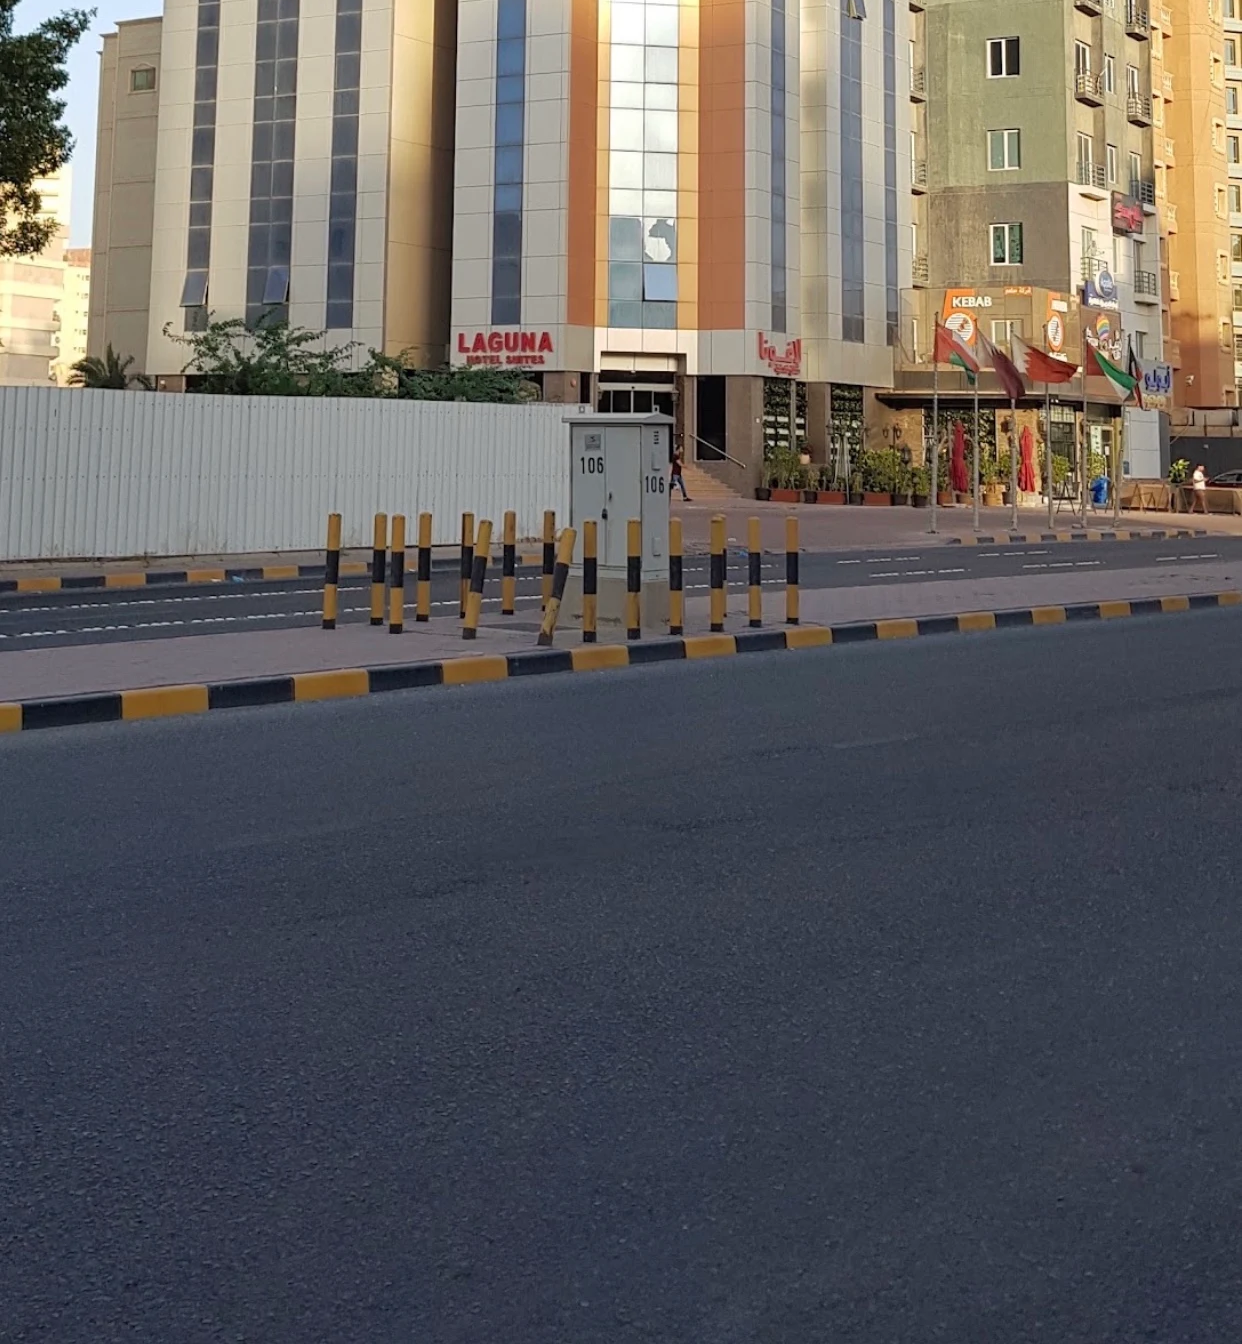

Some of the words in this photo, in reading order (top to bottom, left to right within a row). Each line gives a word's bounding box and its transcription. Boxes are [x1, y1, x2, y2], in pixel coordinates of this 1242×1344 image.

[952, 296, 992, 307] KEBAB
[458, 332, 553, 353] LAGUNA
[466, 355, 502, 365] HOTEL
[505, 355, 545, 365] SUITES
[580, 456, 604, 474] 106
[645, 475, 665, 493] 106
